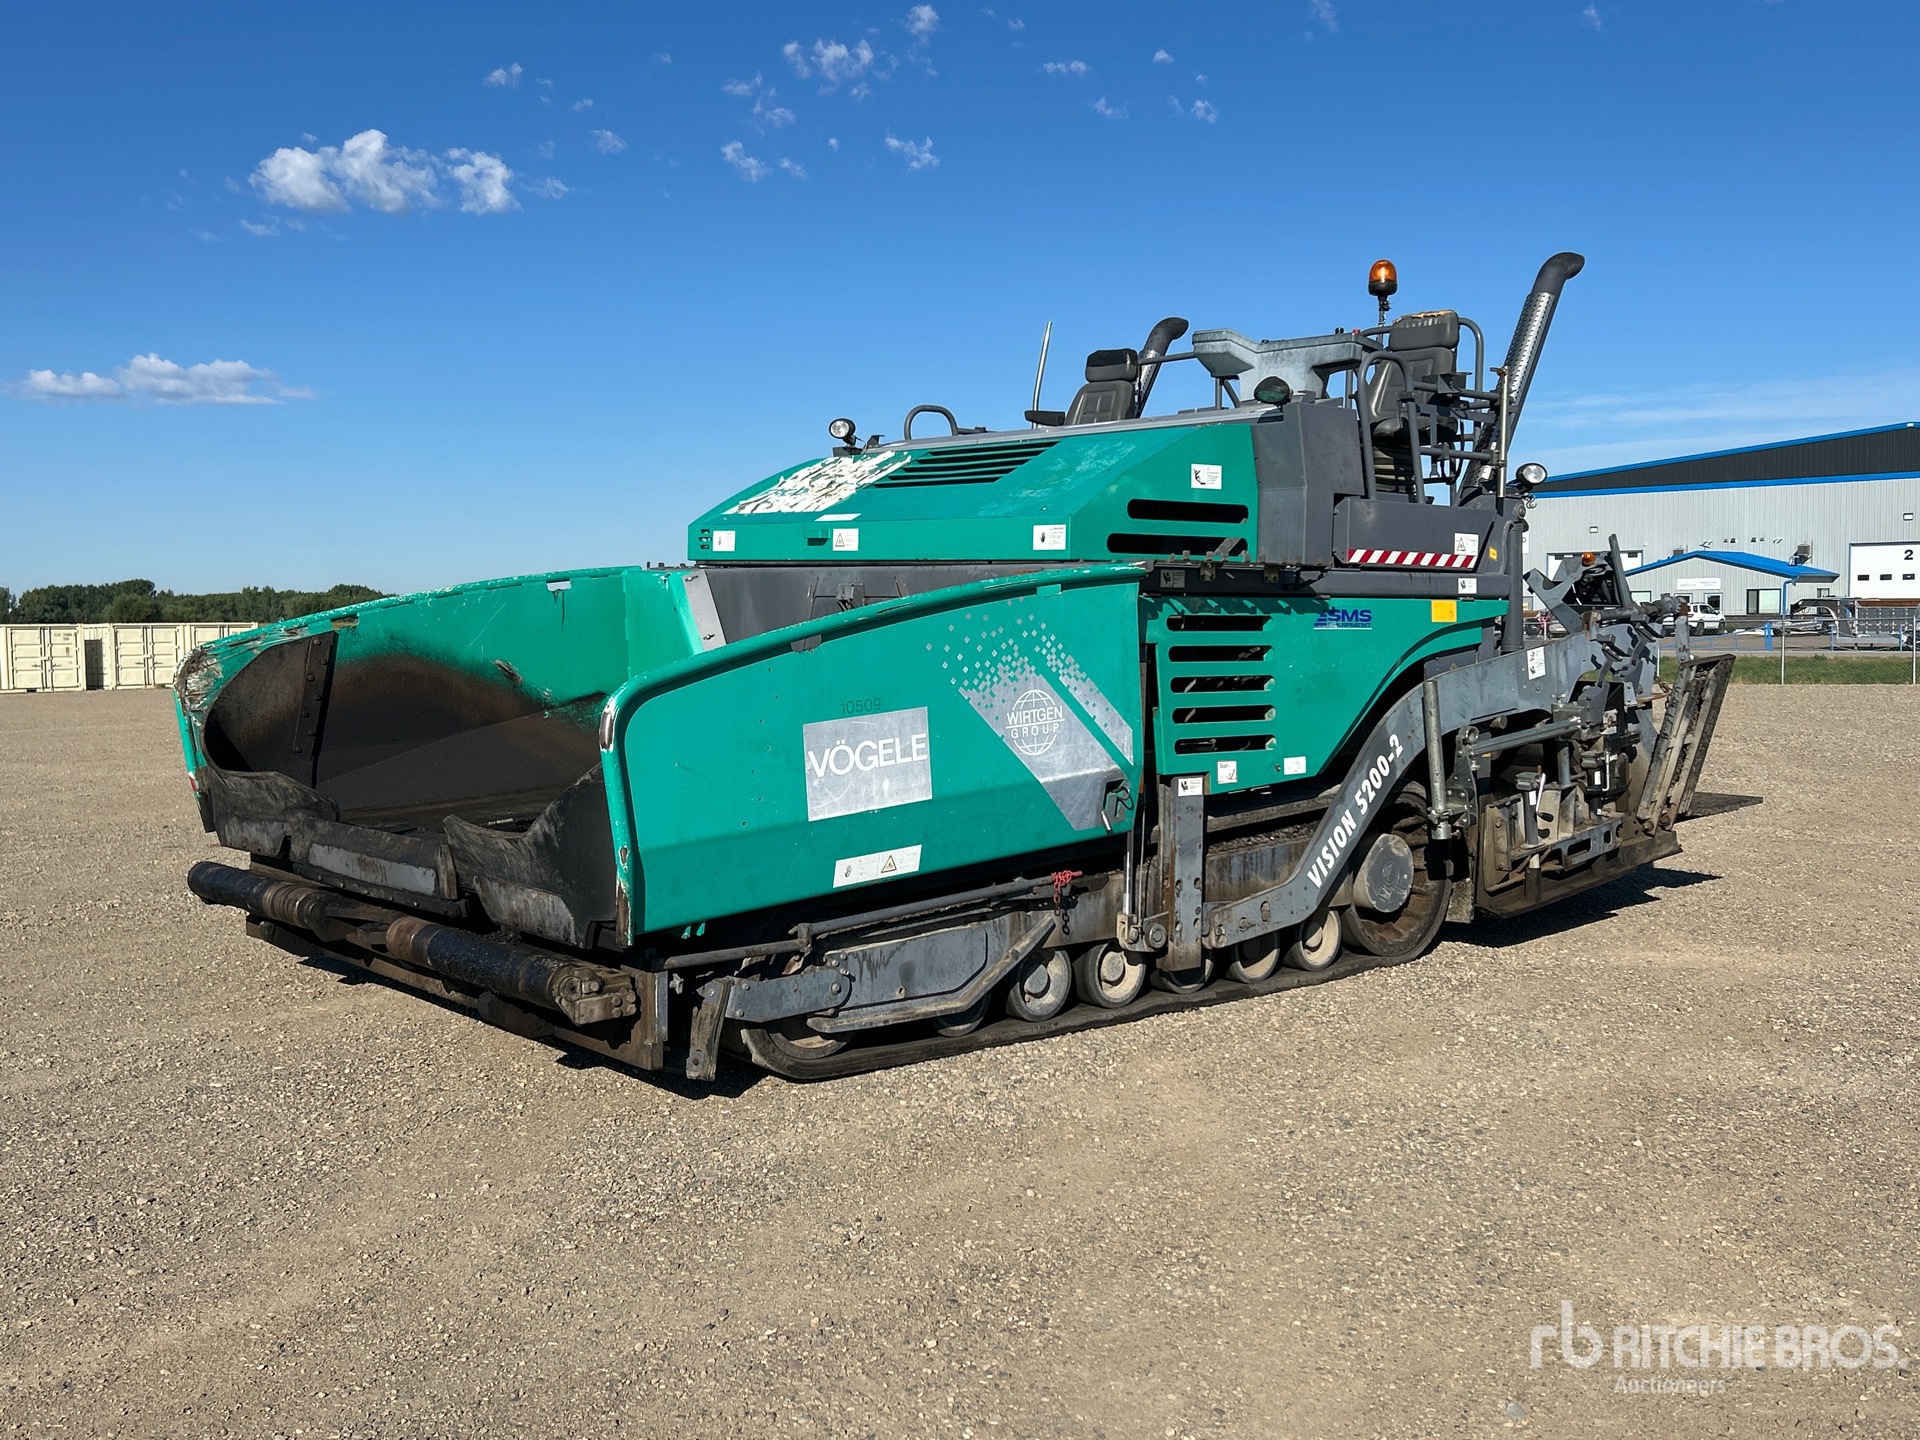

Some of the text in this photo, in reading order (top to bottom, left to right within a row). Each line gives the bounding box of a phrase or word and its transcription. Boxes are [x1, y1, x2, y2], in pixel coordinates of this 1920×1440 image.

[1903, 549, 1914, 561] 2
[1327, 608, 1373, 623] SMS
[840, 697, 882, 715] 10509
[1006, 705, 1063, 726] WIRTGEN
[1010, 722, 1060, 739] GROUP
[807, 732, 929, 778] VÖGELE
[1306, 733, 1404, 889] VISION 5200-2
